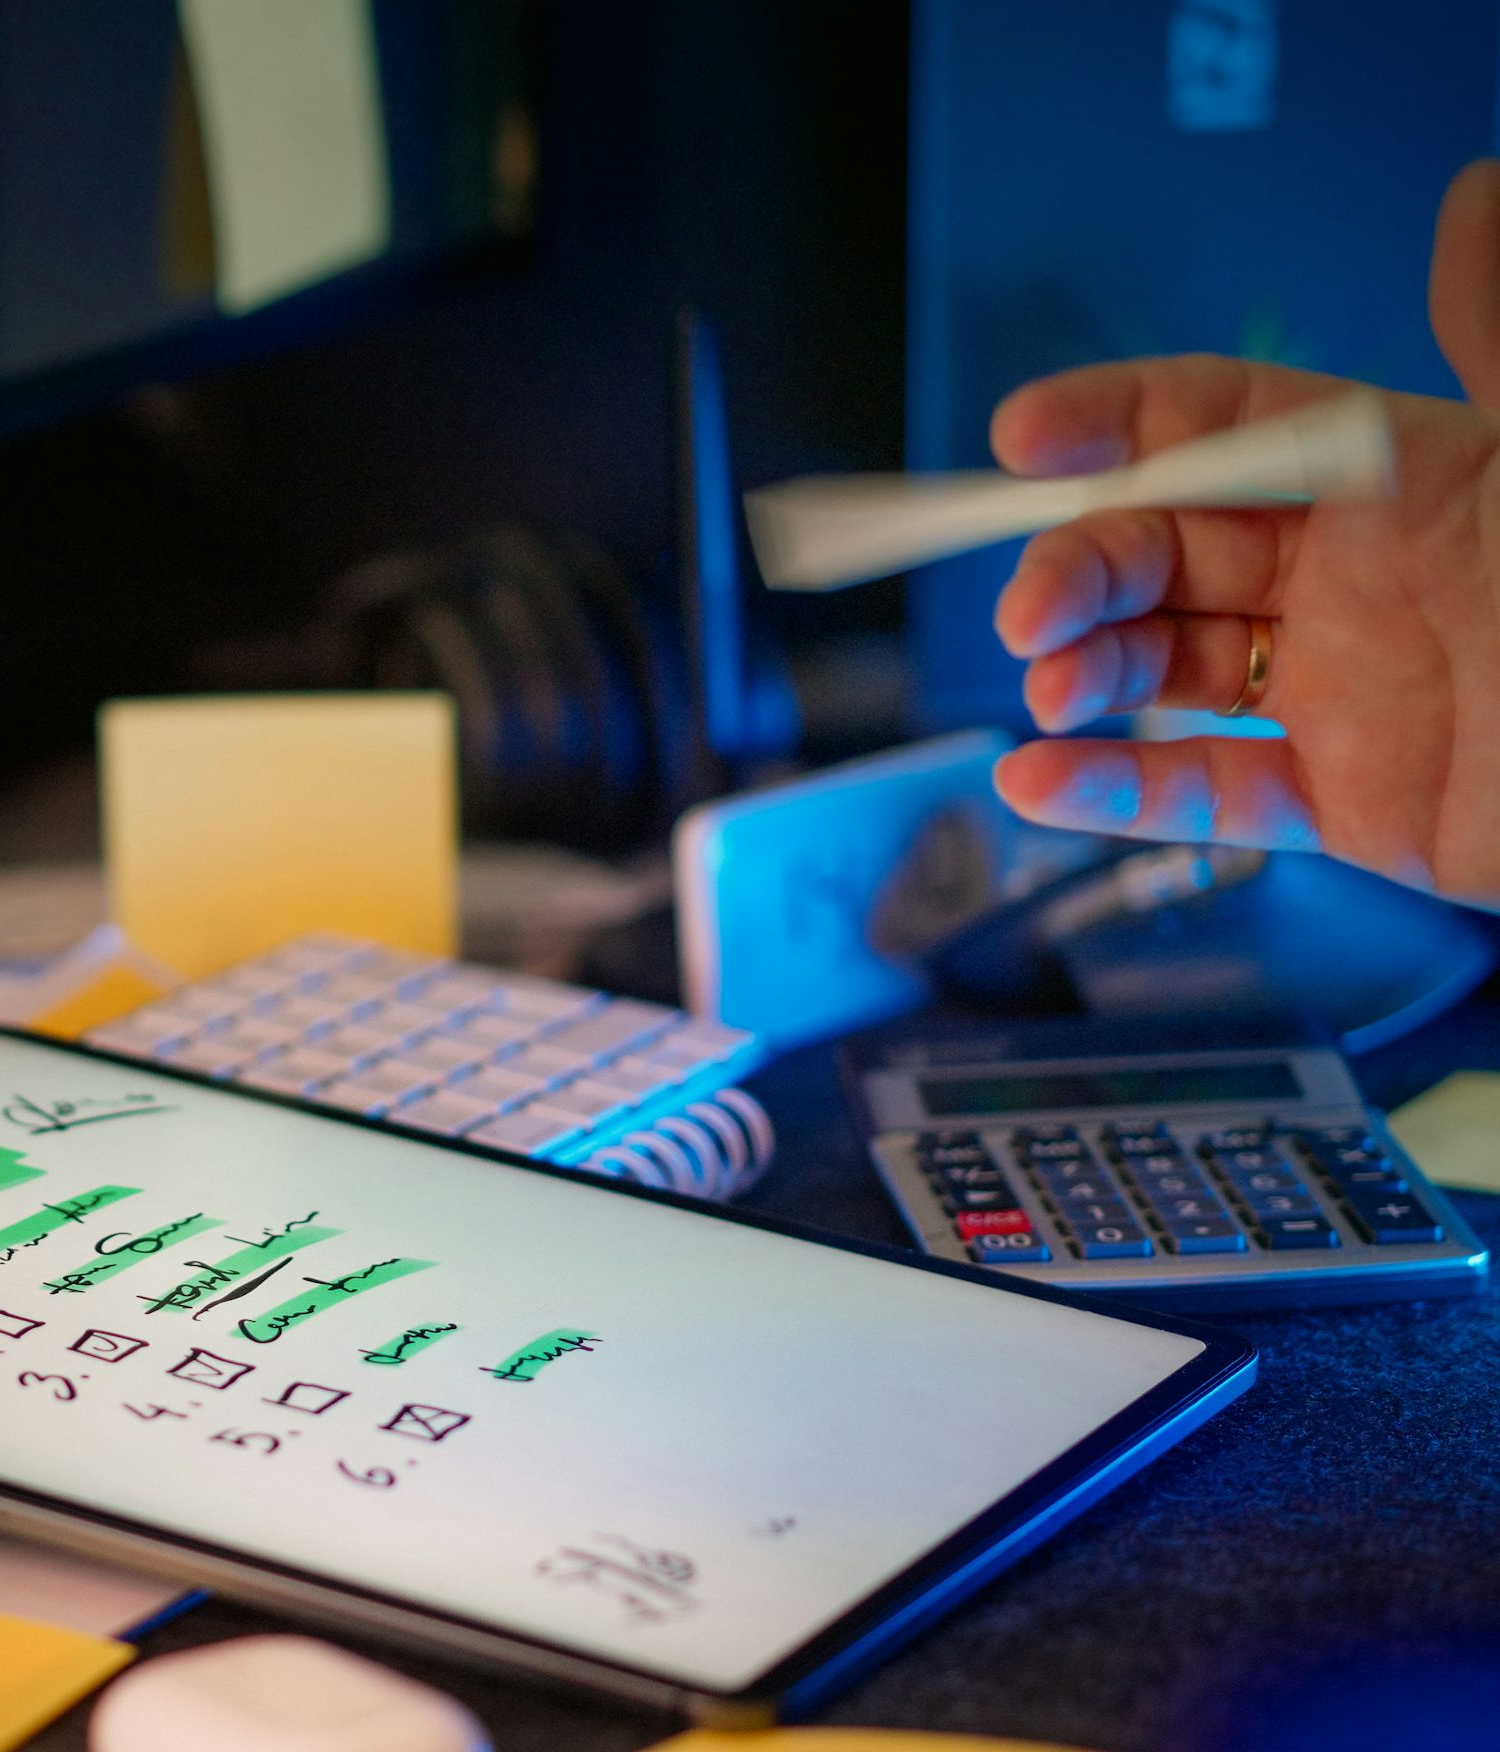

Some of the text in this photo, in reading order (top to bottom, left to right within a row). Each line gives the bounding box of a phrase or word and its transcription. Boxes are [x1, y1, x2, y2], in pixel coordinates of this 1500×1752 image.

[1174, 1200, 1201, 1216] 2
[983, 1232, 1032, 1249] 00
[1096, 1227, 1123, 1243] 0
